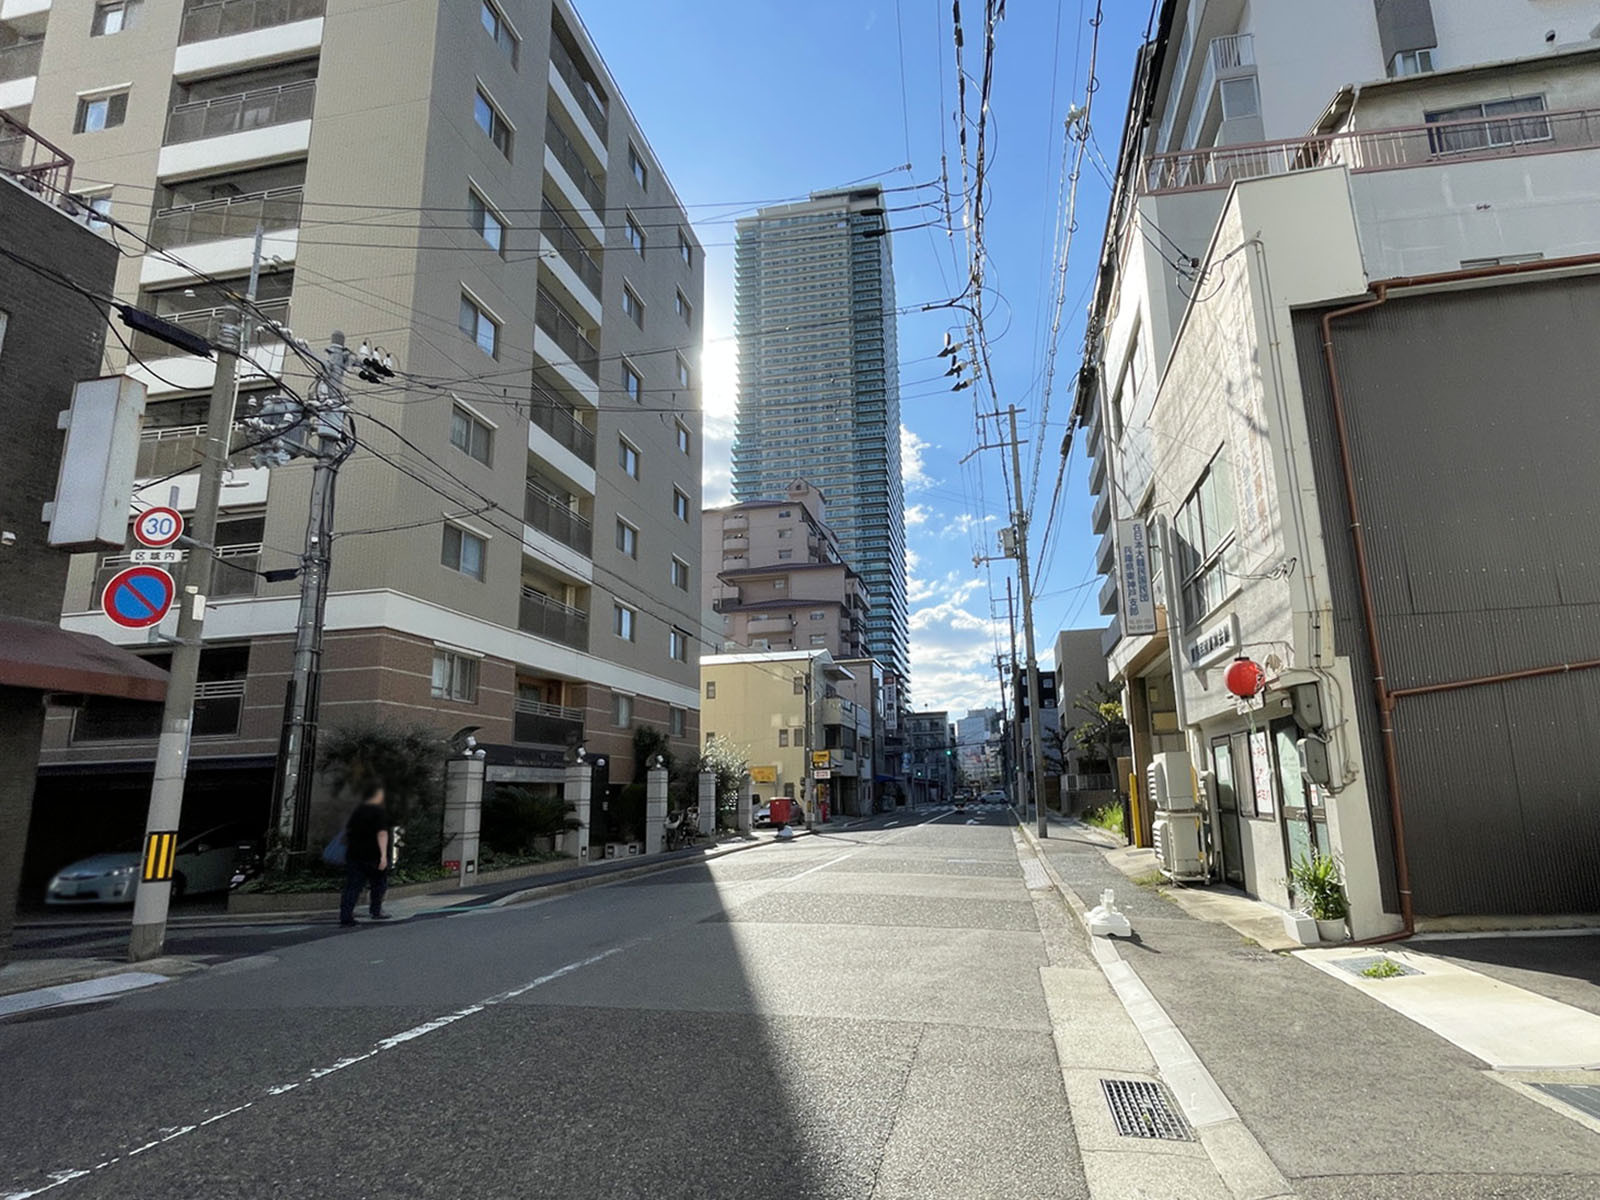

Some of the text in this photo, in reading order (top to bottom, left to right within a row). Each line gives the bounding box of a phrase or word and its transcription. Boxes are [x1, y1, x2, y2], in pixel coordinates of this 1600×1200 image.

[146, 518, 172, 535] 30
[135, 552, 175, 561] 区域内
